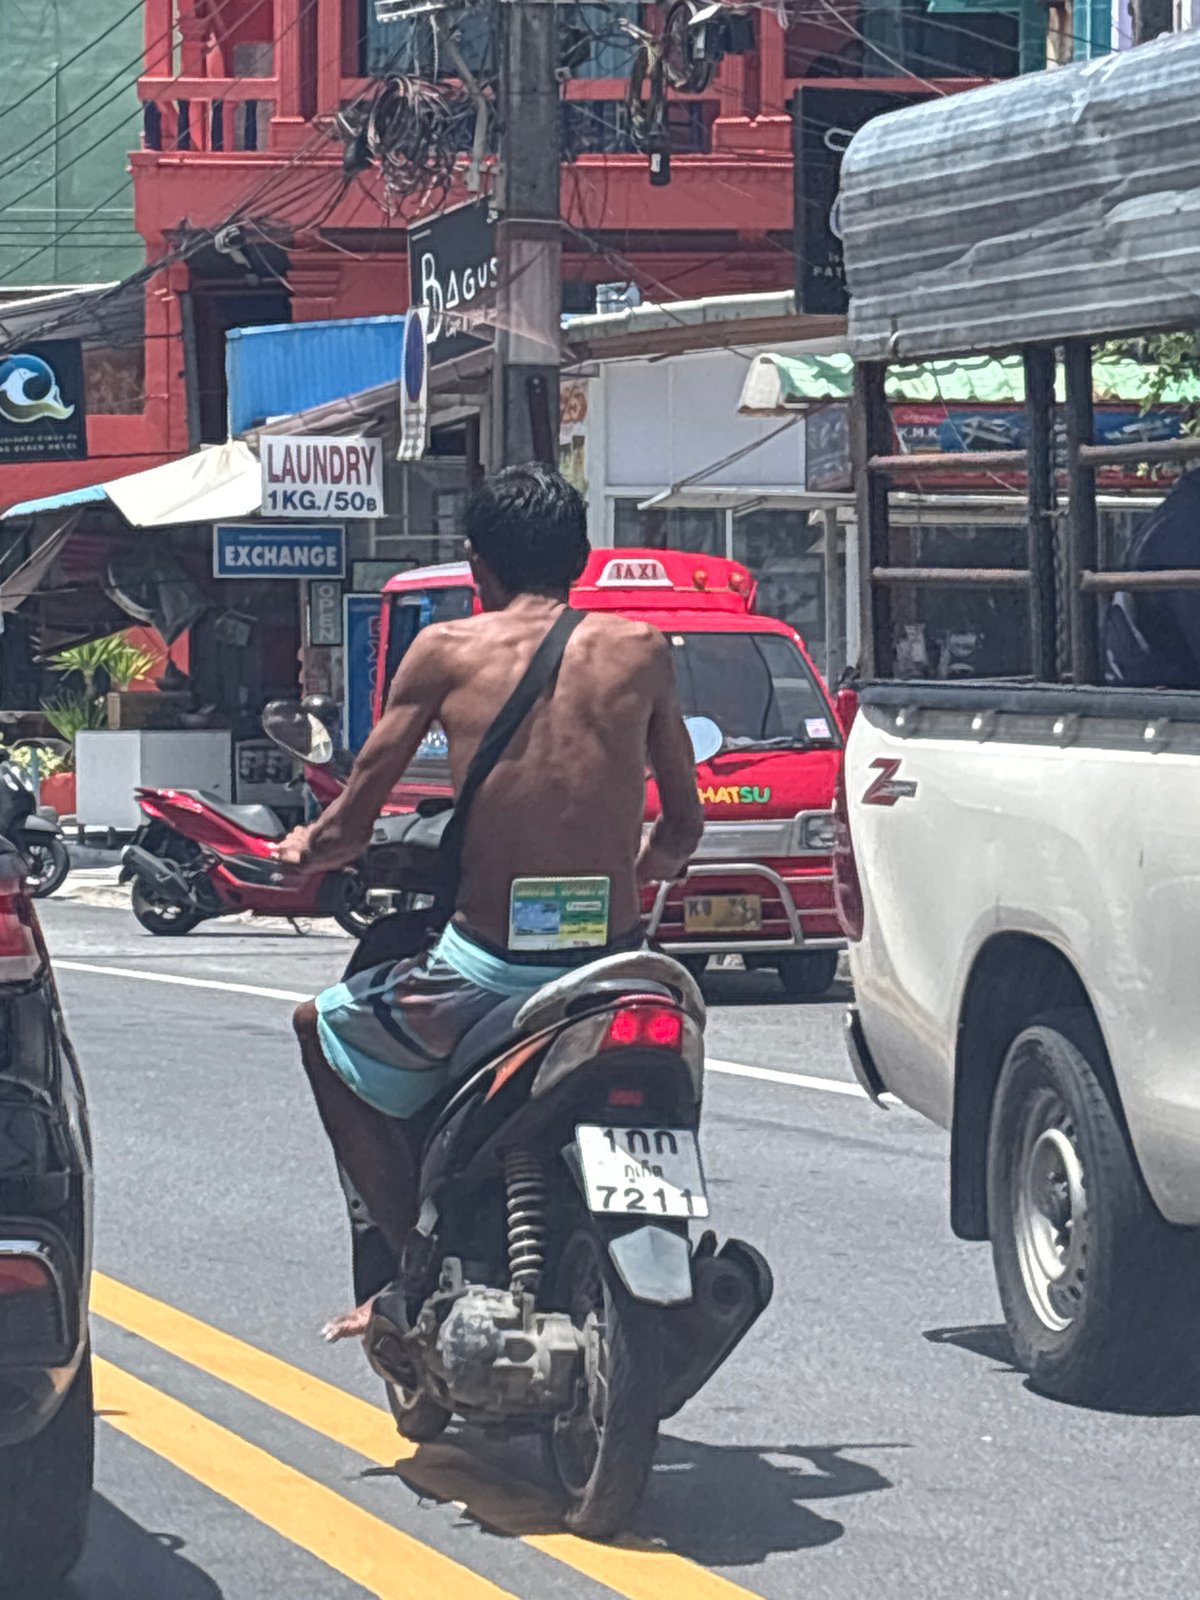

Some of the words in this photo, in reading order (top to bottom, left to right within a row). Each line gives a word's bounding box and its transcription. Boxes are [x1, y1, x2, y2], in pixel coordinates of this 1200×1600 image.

[267, 443, 376, 486] LAUNDRY
[224, 545, 338, 567] EXCHANGE
[613, 563, 659, 580] TAXI
[318, 584, 336, 642] OPEN
[596, 1185, 694, 1216] 7211
